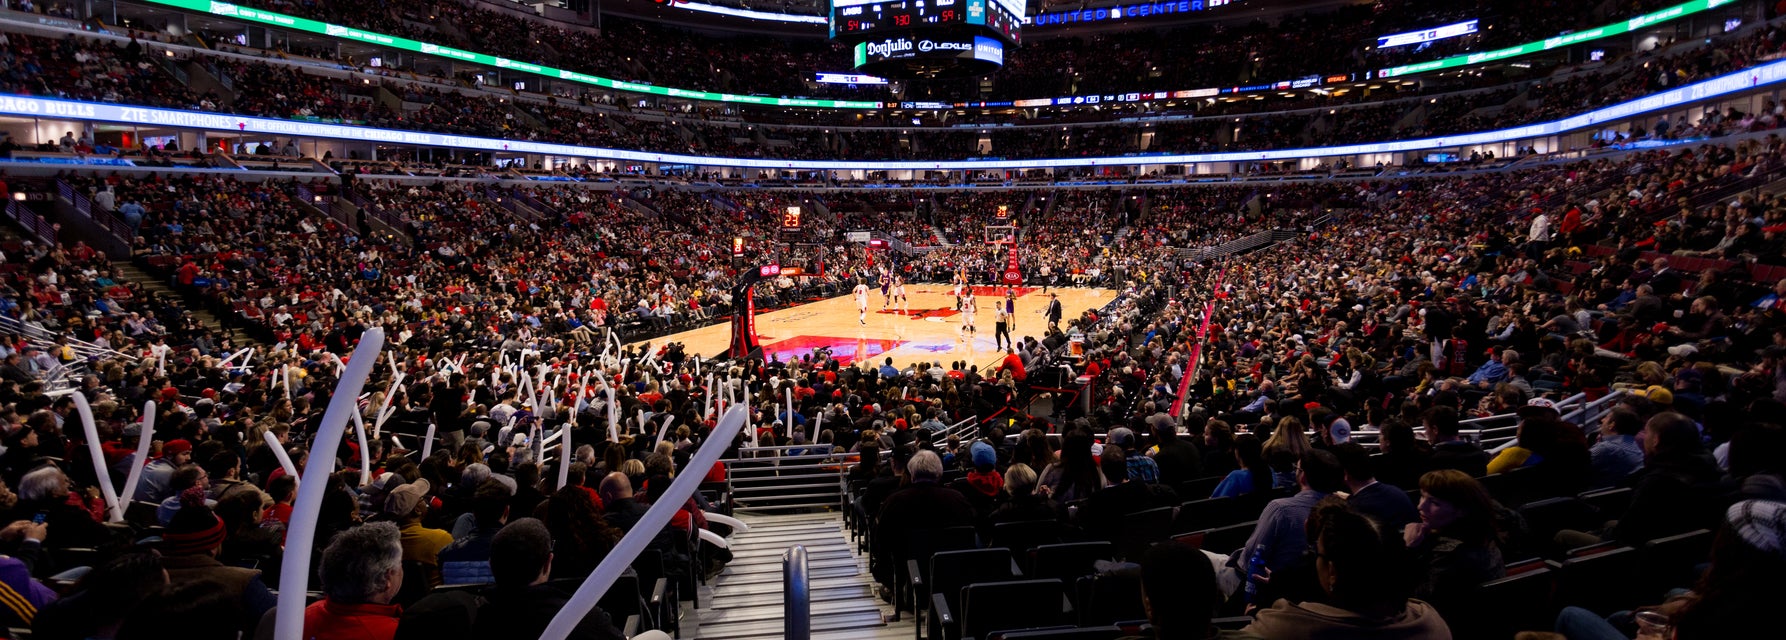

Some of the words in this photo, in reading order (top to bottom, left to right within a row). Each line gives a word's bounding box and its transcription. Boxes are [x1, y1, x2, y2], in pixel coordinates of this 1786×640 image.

[941, 10, 954, 22] 59
[1036, 8, 1108, 26] UNITED
[1126, 0, 1204, 17] CENTER
[847, 20, 859, 31] 54
[934, 42, 972, 50] LEXUS
[45, 101, 95, 117] BULLS
[120, 108, 148, 122] ZTE
[151, 110, 231, 129] SMARTPHONES
[252, 120, 267, 130] THE
[267, 121, 297, 133] OFFICIAL
[298, 125, 341, 137] SMARTPHONE
[342, 128, 351, 137] OF
[351, 128, 363, 138] THE
[364, 129, 403, 141] CHICAGO
[405, 133, 430, 144] BULLS
[442, 135, 457, 146] ZTE
[997, 209, 1006, 217] 23
[785, 214, 798, 226] 23
